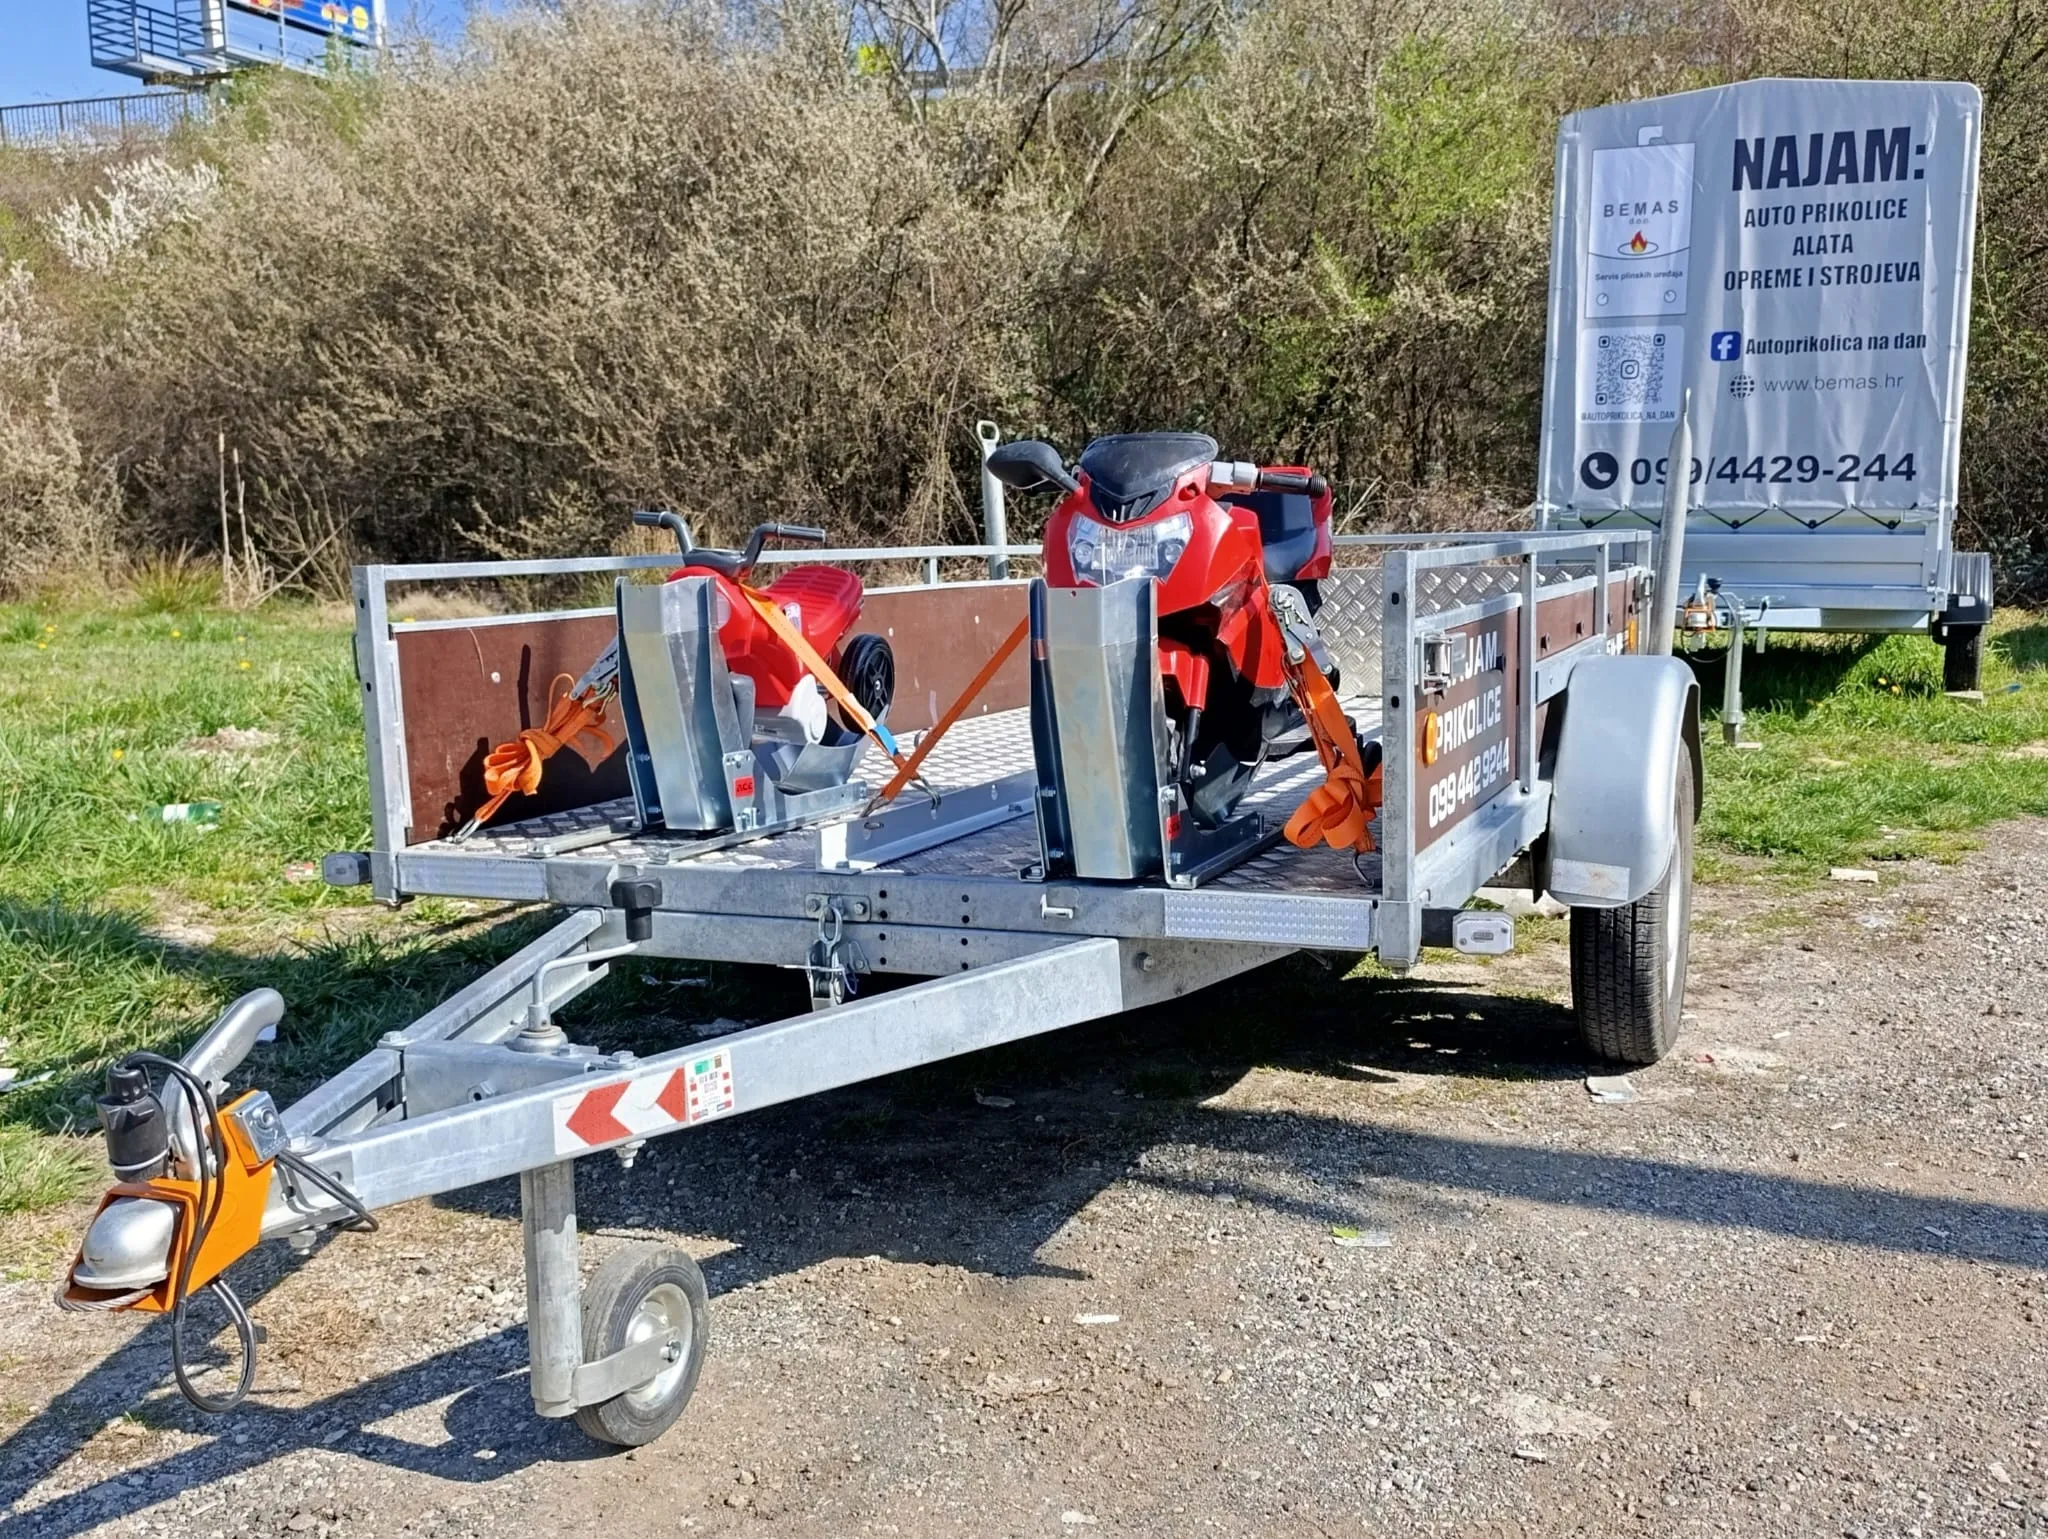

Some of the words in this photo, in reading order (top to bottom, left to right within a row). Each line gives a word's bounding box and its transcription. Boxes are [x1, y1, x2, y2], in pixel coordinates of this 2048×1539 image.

[1732, 127, 1926, 191] NAJAM:
[1603, 199, 1679, 218] BEMAS
[1744, 205, 1796, 228] AUTO
[1801, 198, 1908, 224] PRIKOLICE
[1792, 234, 1854, 257] ALATA
[1595, 273, 1619, 281] Servis
[1620, 271, 1652, 282] plinskih
[1724, 266, 1802, 291] OPREME
[1808, 266, 1815, 287] I
[1820, 261, 1921, 286] STROJEVA
[1745, 334, 1864, 356] Autoprikolica
[1867, 336, 1891, 351] na
[1893, 332, 1927, 350] dan
[1763, 373, 1904, 392] www.bemas.hr
[1429, 772, 1457, 828] 099
[1457, 755, 1481, 804] 442
[1482, 737, 1510, 788] 9244
